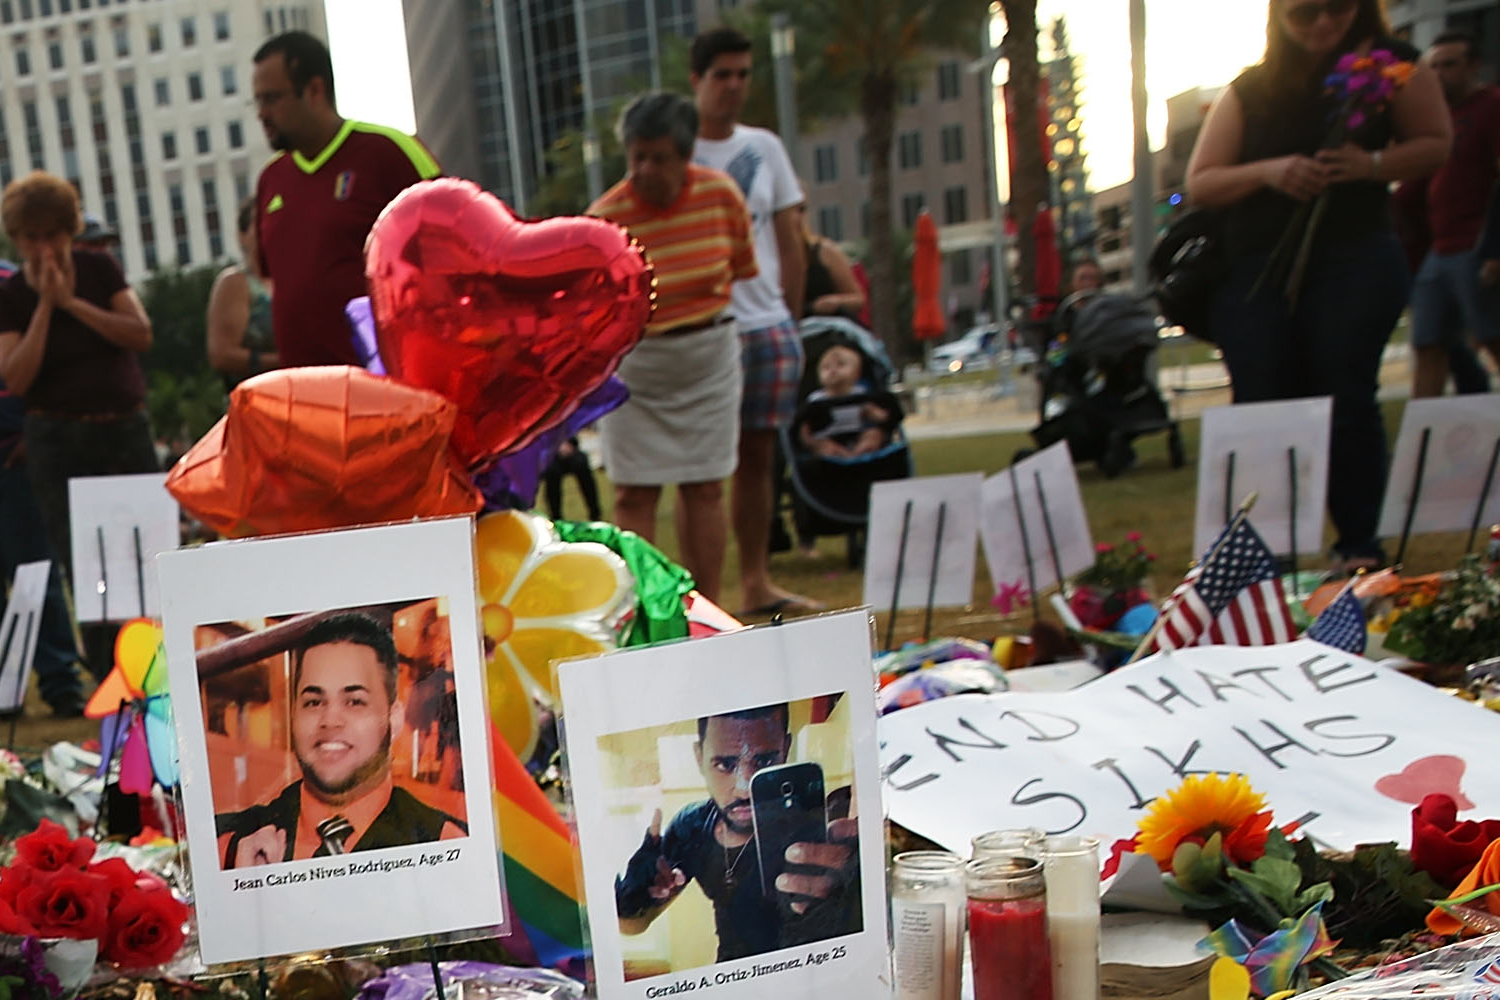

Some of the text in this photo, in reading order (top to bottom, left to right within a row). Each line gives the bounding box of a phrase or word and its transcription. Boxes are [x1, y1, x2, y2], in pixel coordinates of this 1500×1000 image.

[880, 654, 1378, 791] END HATE
[1011, 714, 1396, 836] SIKHS
[233, 848, 461, 892] Jean Carlos Nives Rodriguez, Age 27
[646, 946, 847, 1000] Geraldo A. Ortiz-Jimenez, Age 25
